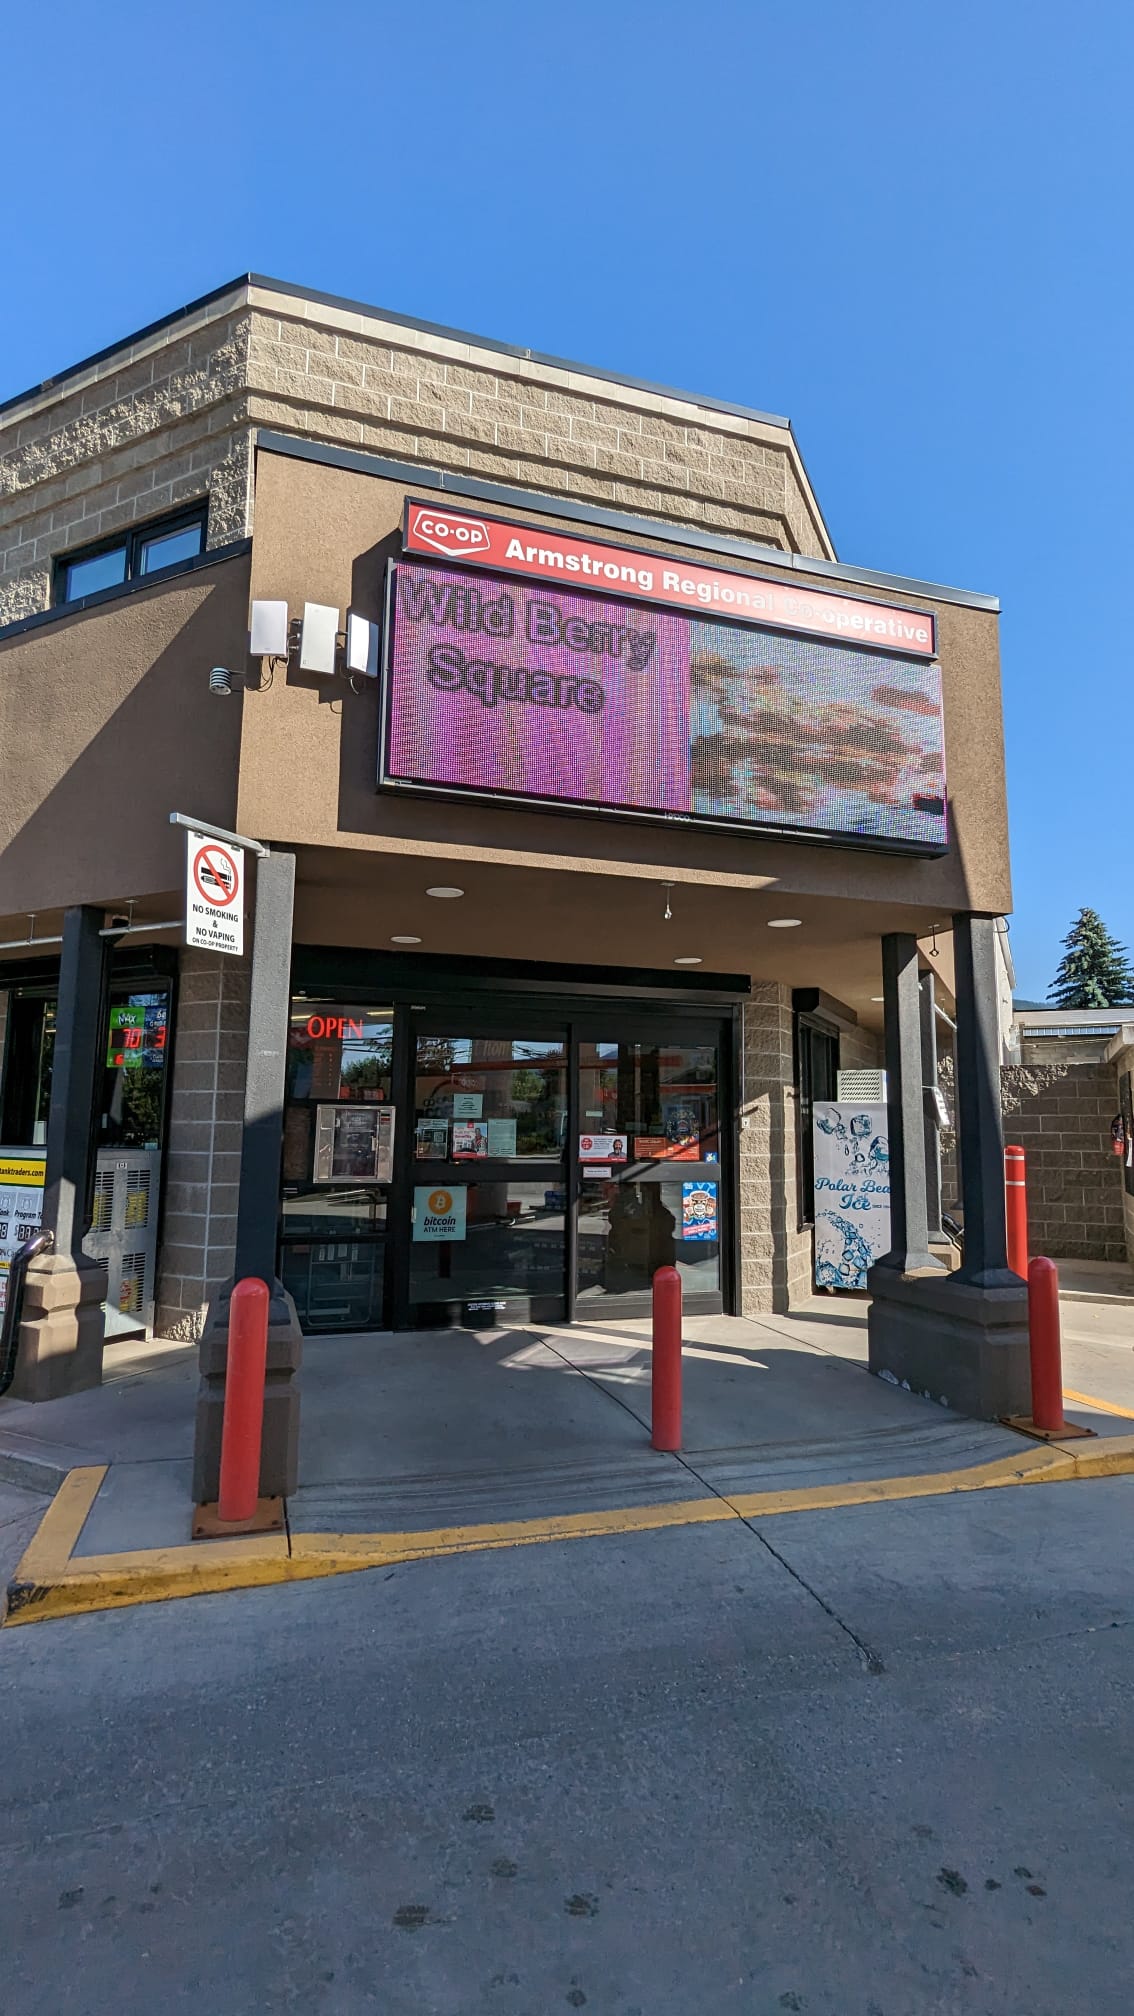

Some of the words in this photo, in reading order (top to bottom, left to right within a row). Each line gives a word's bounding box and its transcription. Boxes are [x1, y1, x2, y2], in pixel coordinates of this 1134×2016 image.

[421, 520, 482, 544] CO-OP
[505, 538, 653, 591] Armstrong
[662, 571, 774, 610] Regional
[783, 597, 929, 643] Co-operative
[399, 575, 515, 639] Wild
[525, 599, 657, 671] Berry
[427, 643, 605, 714] Square
[192, 904, 204, 914] NO
[205, 907, 239, 923] SMOKING
[212, 920, 218, 928] &
[196, 927, 207, 937] NO
[208, 930, 235, 943] VAPING
[216, 942, 238, 952] PROPERTY
[307, 1016, 364, 1039] OPEN
[815, 1177, 857, 1191] Polar
[860, 1180, 891, 1193] Bea
[839, 1193, 871, 1210] Ice
[424, 1216, 456, 1226] bitcoin
